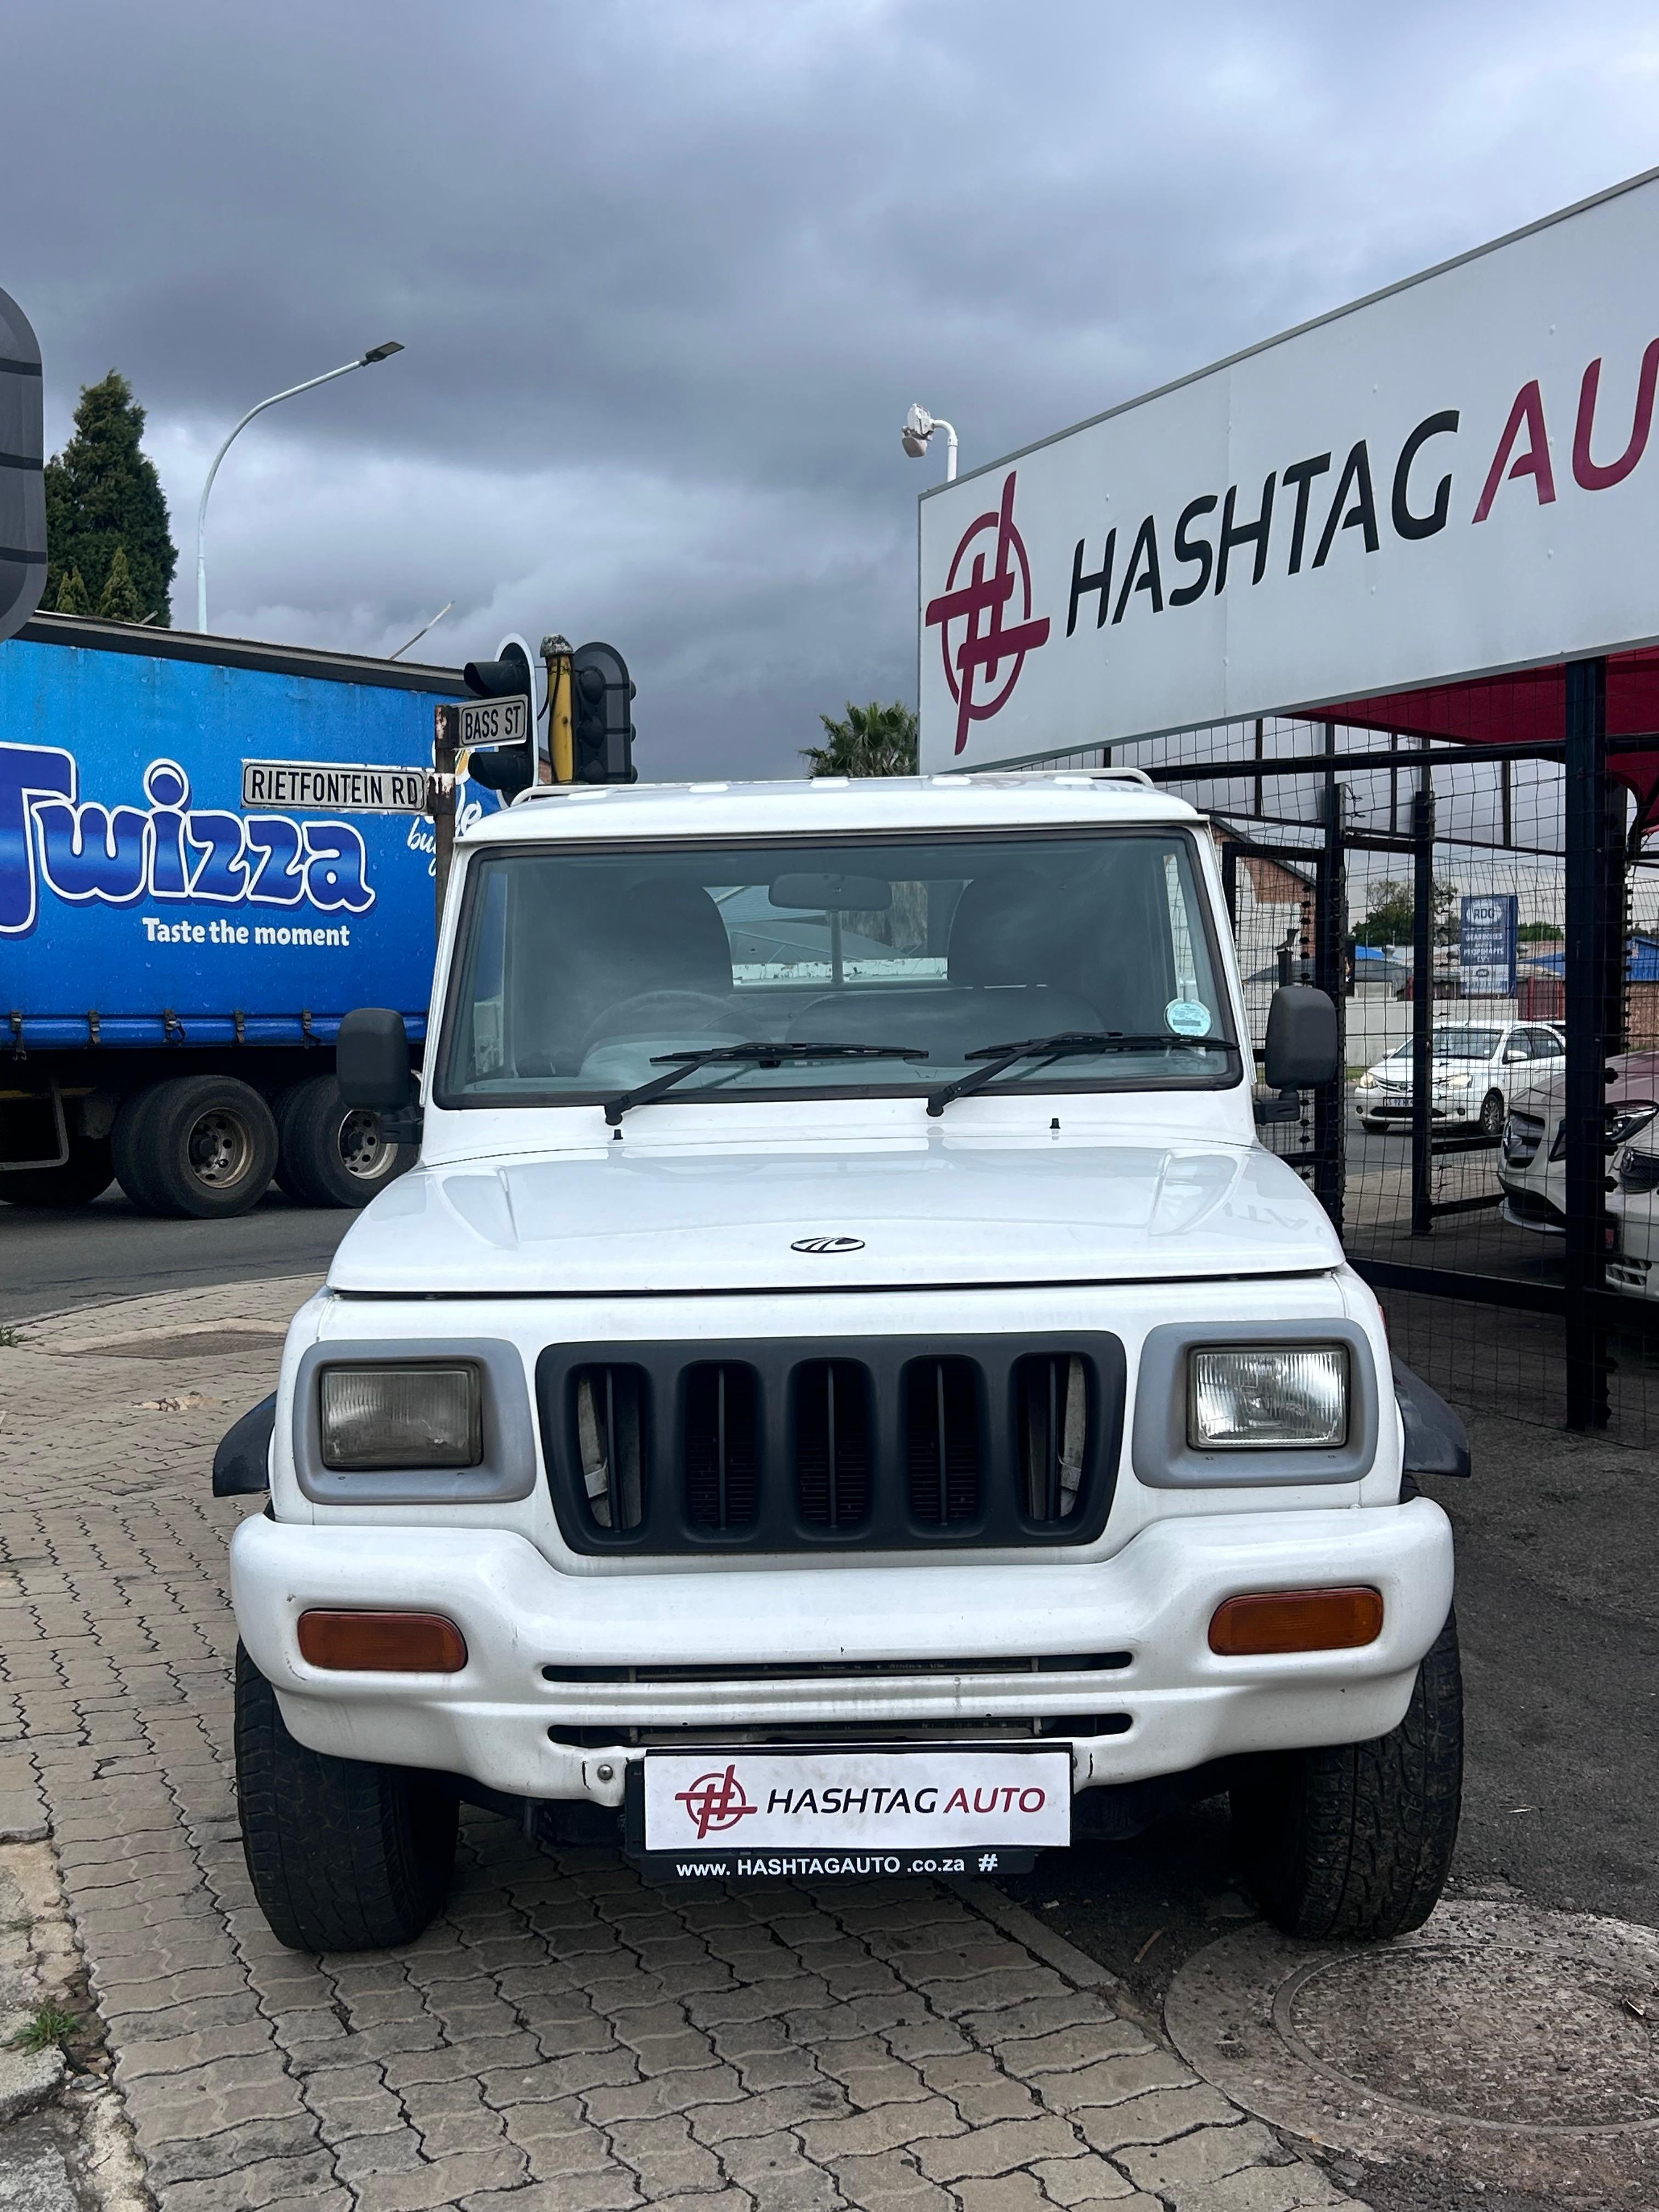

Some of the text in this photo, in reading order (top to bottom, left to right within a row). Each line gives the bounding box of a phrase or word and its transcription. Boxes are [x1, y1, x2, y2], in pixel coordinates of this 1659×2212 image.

[1066, 410, 1460, 638] HASHTAG
[465, 705, 521, 741] BASS ST
[251, 769, 417, 805] RIETFONTEIN RD
[142, 917, 350, 946] Taste the moment
[767, 1787, 1046, 1814] HASHTAG AUTO
[676, 1853, 998, 1876] www. HASHTAGAUTO .co.za #
